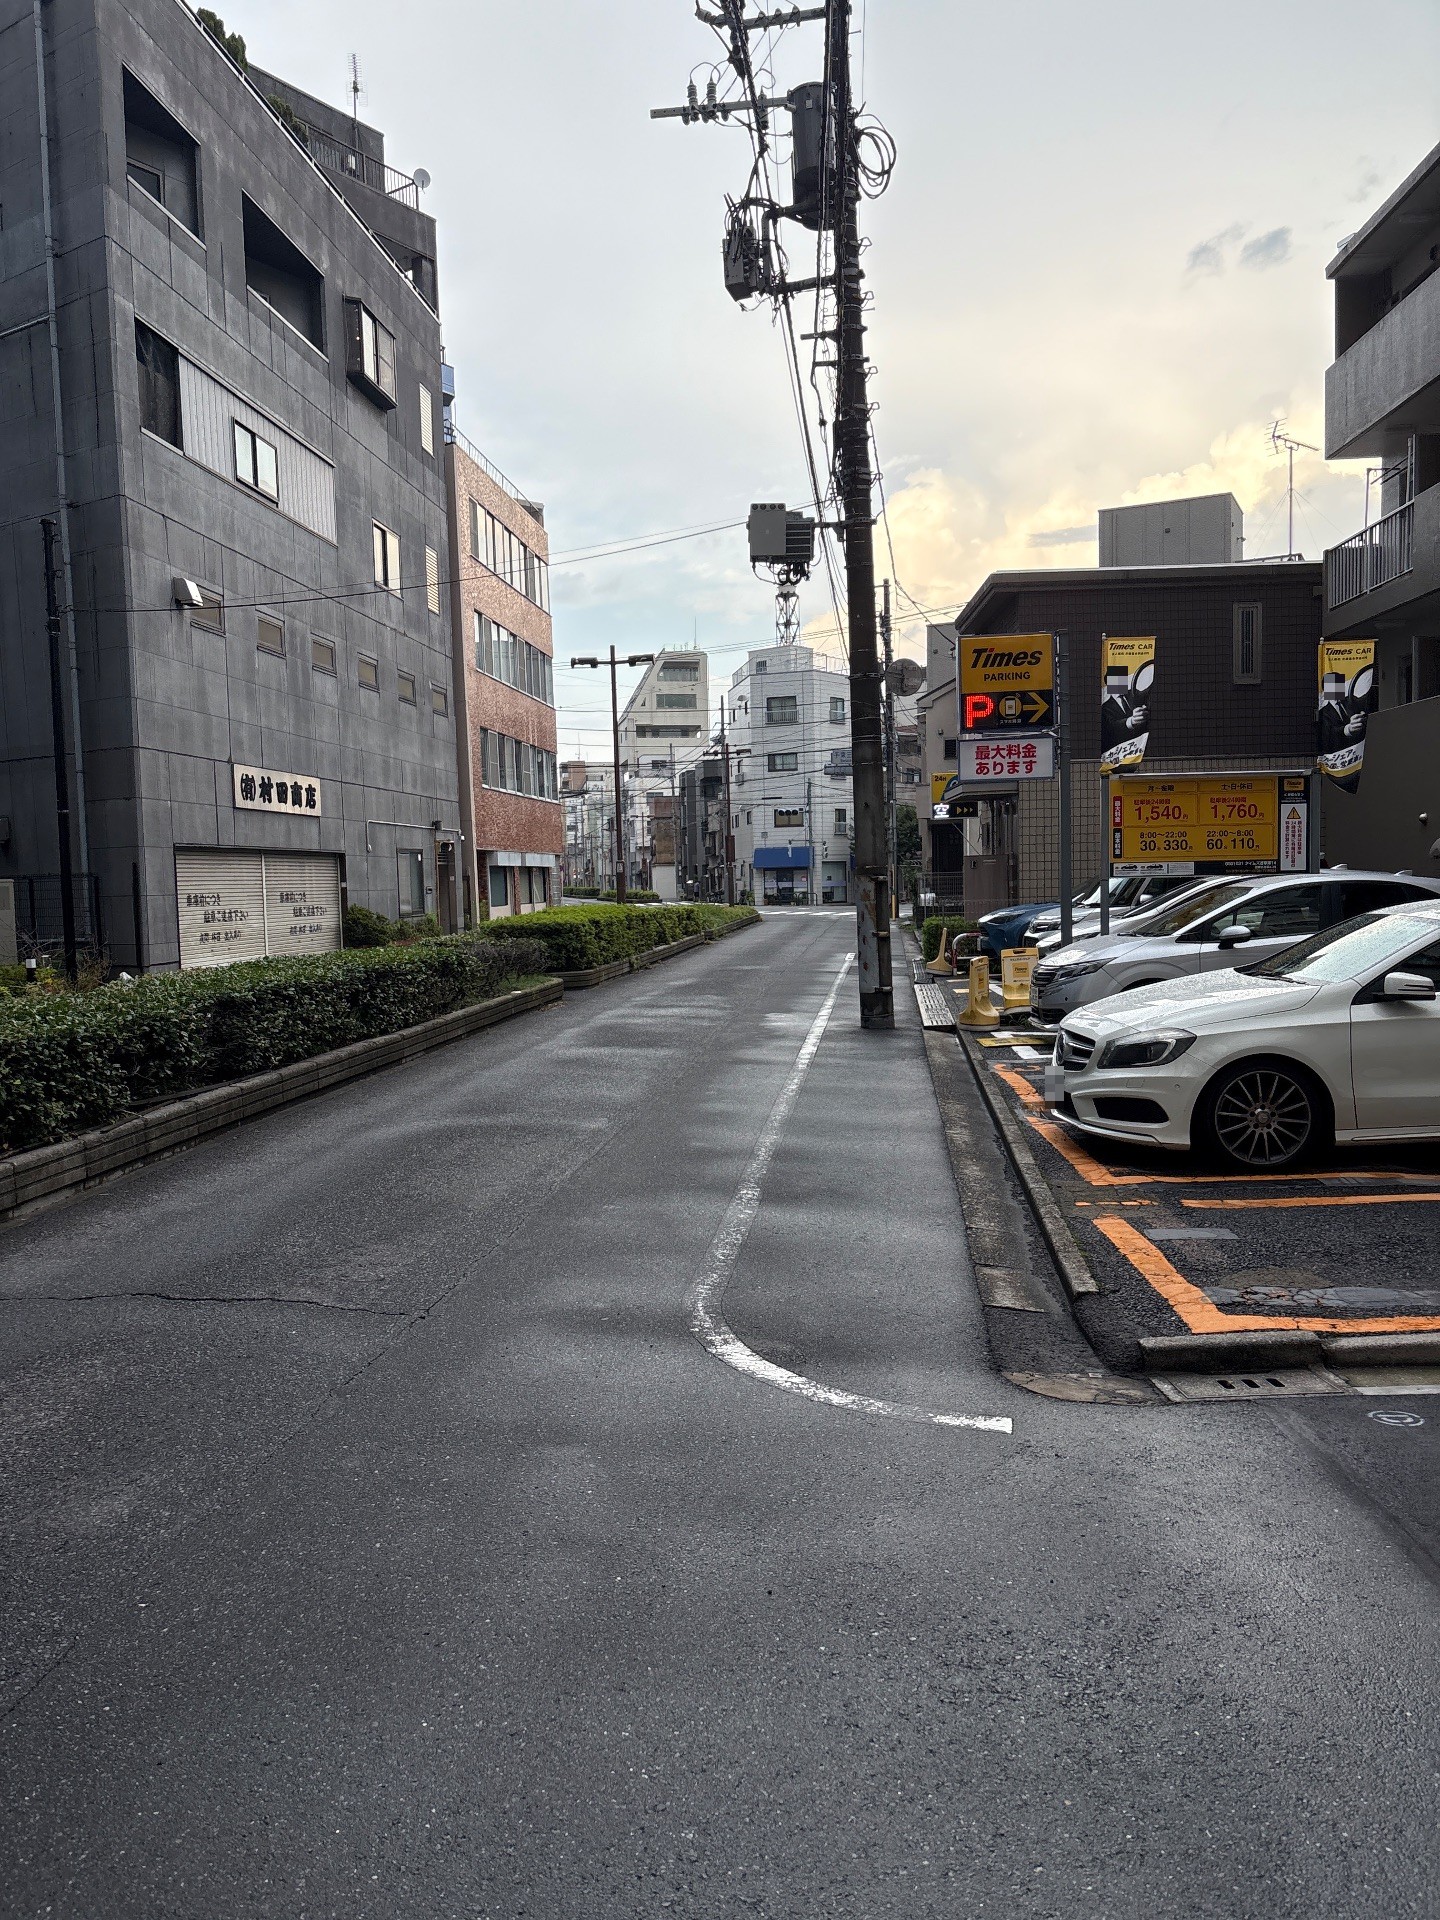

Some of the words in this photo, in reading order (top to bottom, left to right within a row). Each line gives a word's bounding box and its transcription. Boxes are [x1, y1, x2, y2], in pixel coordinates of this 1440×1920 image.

[1109, 642, 1136, 650] Times
[1138, 642, 1153, 650] CAR
[1325, 647, 1353, 656] Times
[1355, 647, 1372, 655] CAR
[971, 647, 1043, 669] Times
[983, 671, 1031, 682] PARKING
[966, 694, 994, 728] P
[975, 743, 1037, 760] 最大料金
[975, 760, 1037, 775] あります
[933, 803, 950, 819] 空
